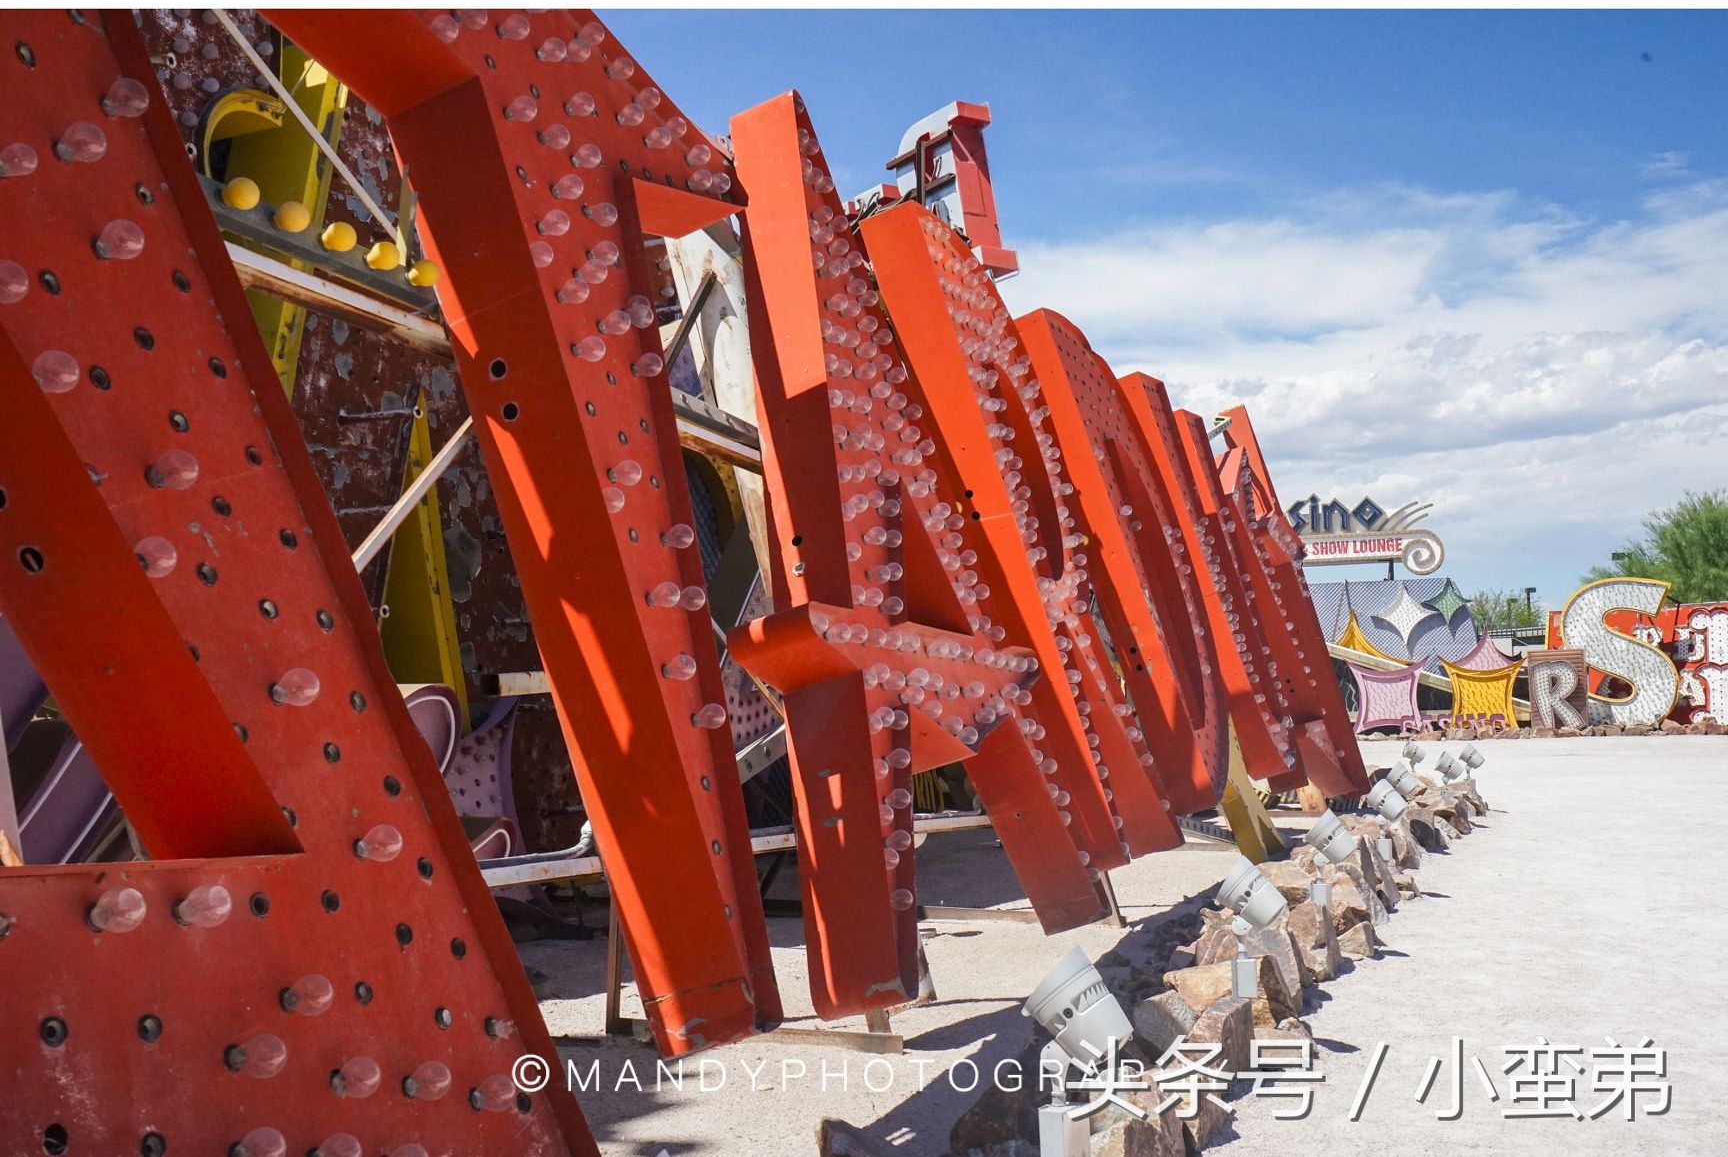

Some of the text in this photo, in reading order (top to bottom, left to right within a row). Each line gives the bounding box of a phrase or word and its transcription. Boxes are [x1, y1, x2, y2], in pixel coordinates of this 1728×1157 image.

[1312, 538, 1404, 556] SHOW LOUNGE
[1560, 577, 1680, 729] S
[1532, 660, 1587, 732] R
